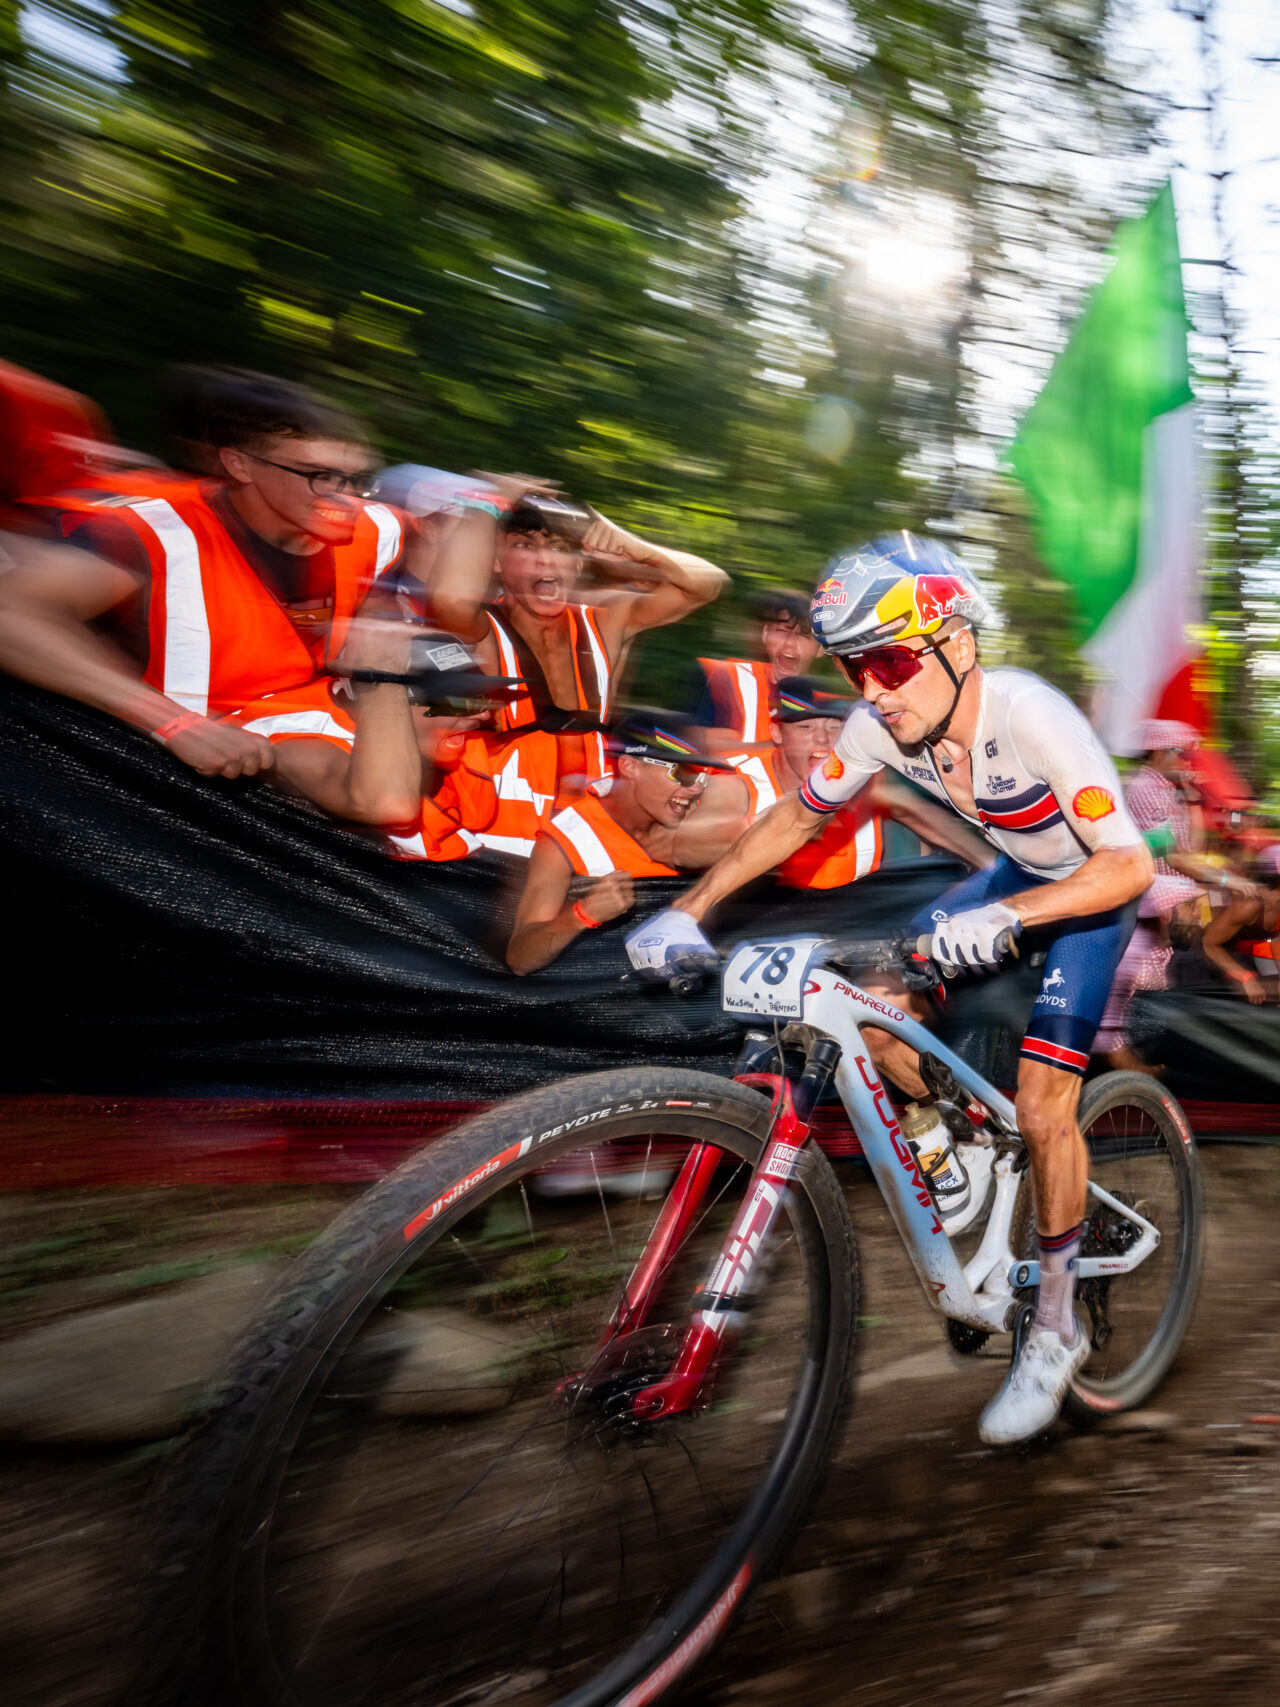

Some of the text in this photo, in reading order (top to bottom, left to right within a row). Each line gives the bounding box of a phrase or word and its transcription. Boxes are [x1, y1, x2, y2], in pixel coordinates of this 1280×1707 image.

[825, 592, 847, 605] Bull
[997, 783, 1017, 793] LOTTERY
[739, 946, 795, 985] 78
[833, 981, 905, 1021] PINARELLO
[538, 1108, 612, 1143] PEYOTE
[444, 1160, 500, 1204] vittoria
